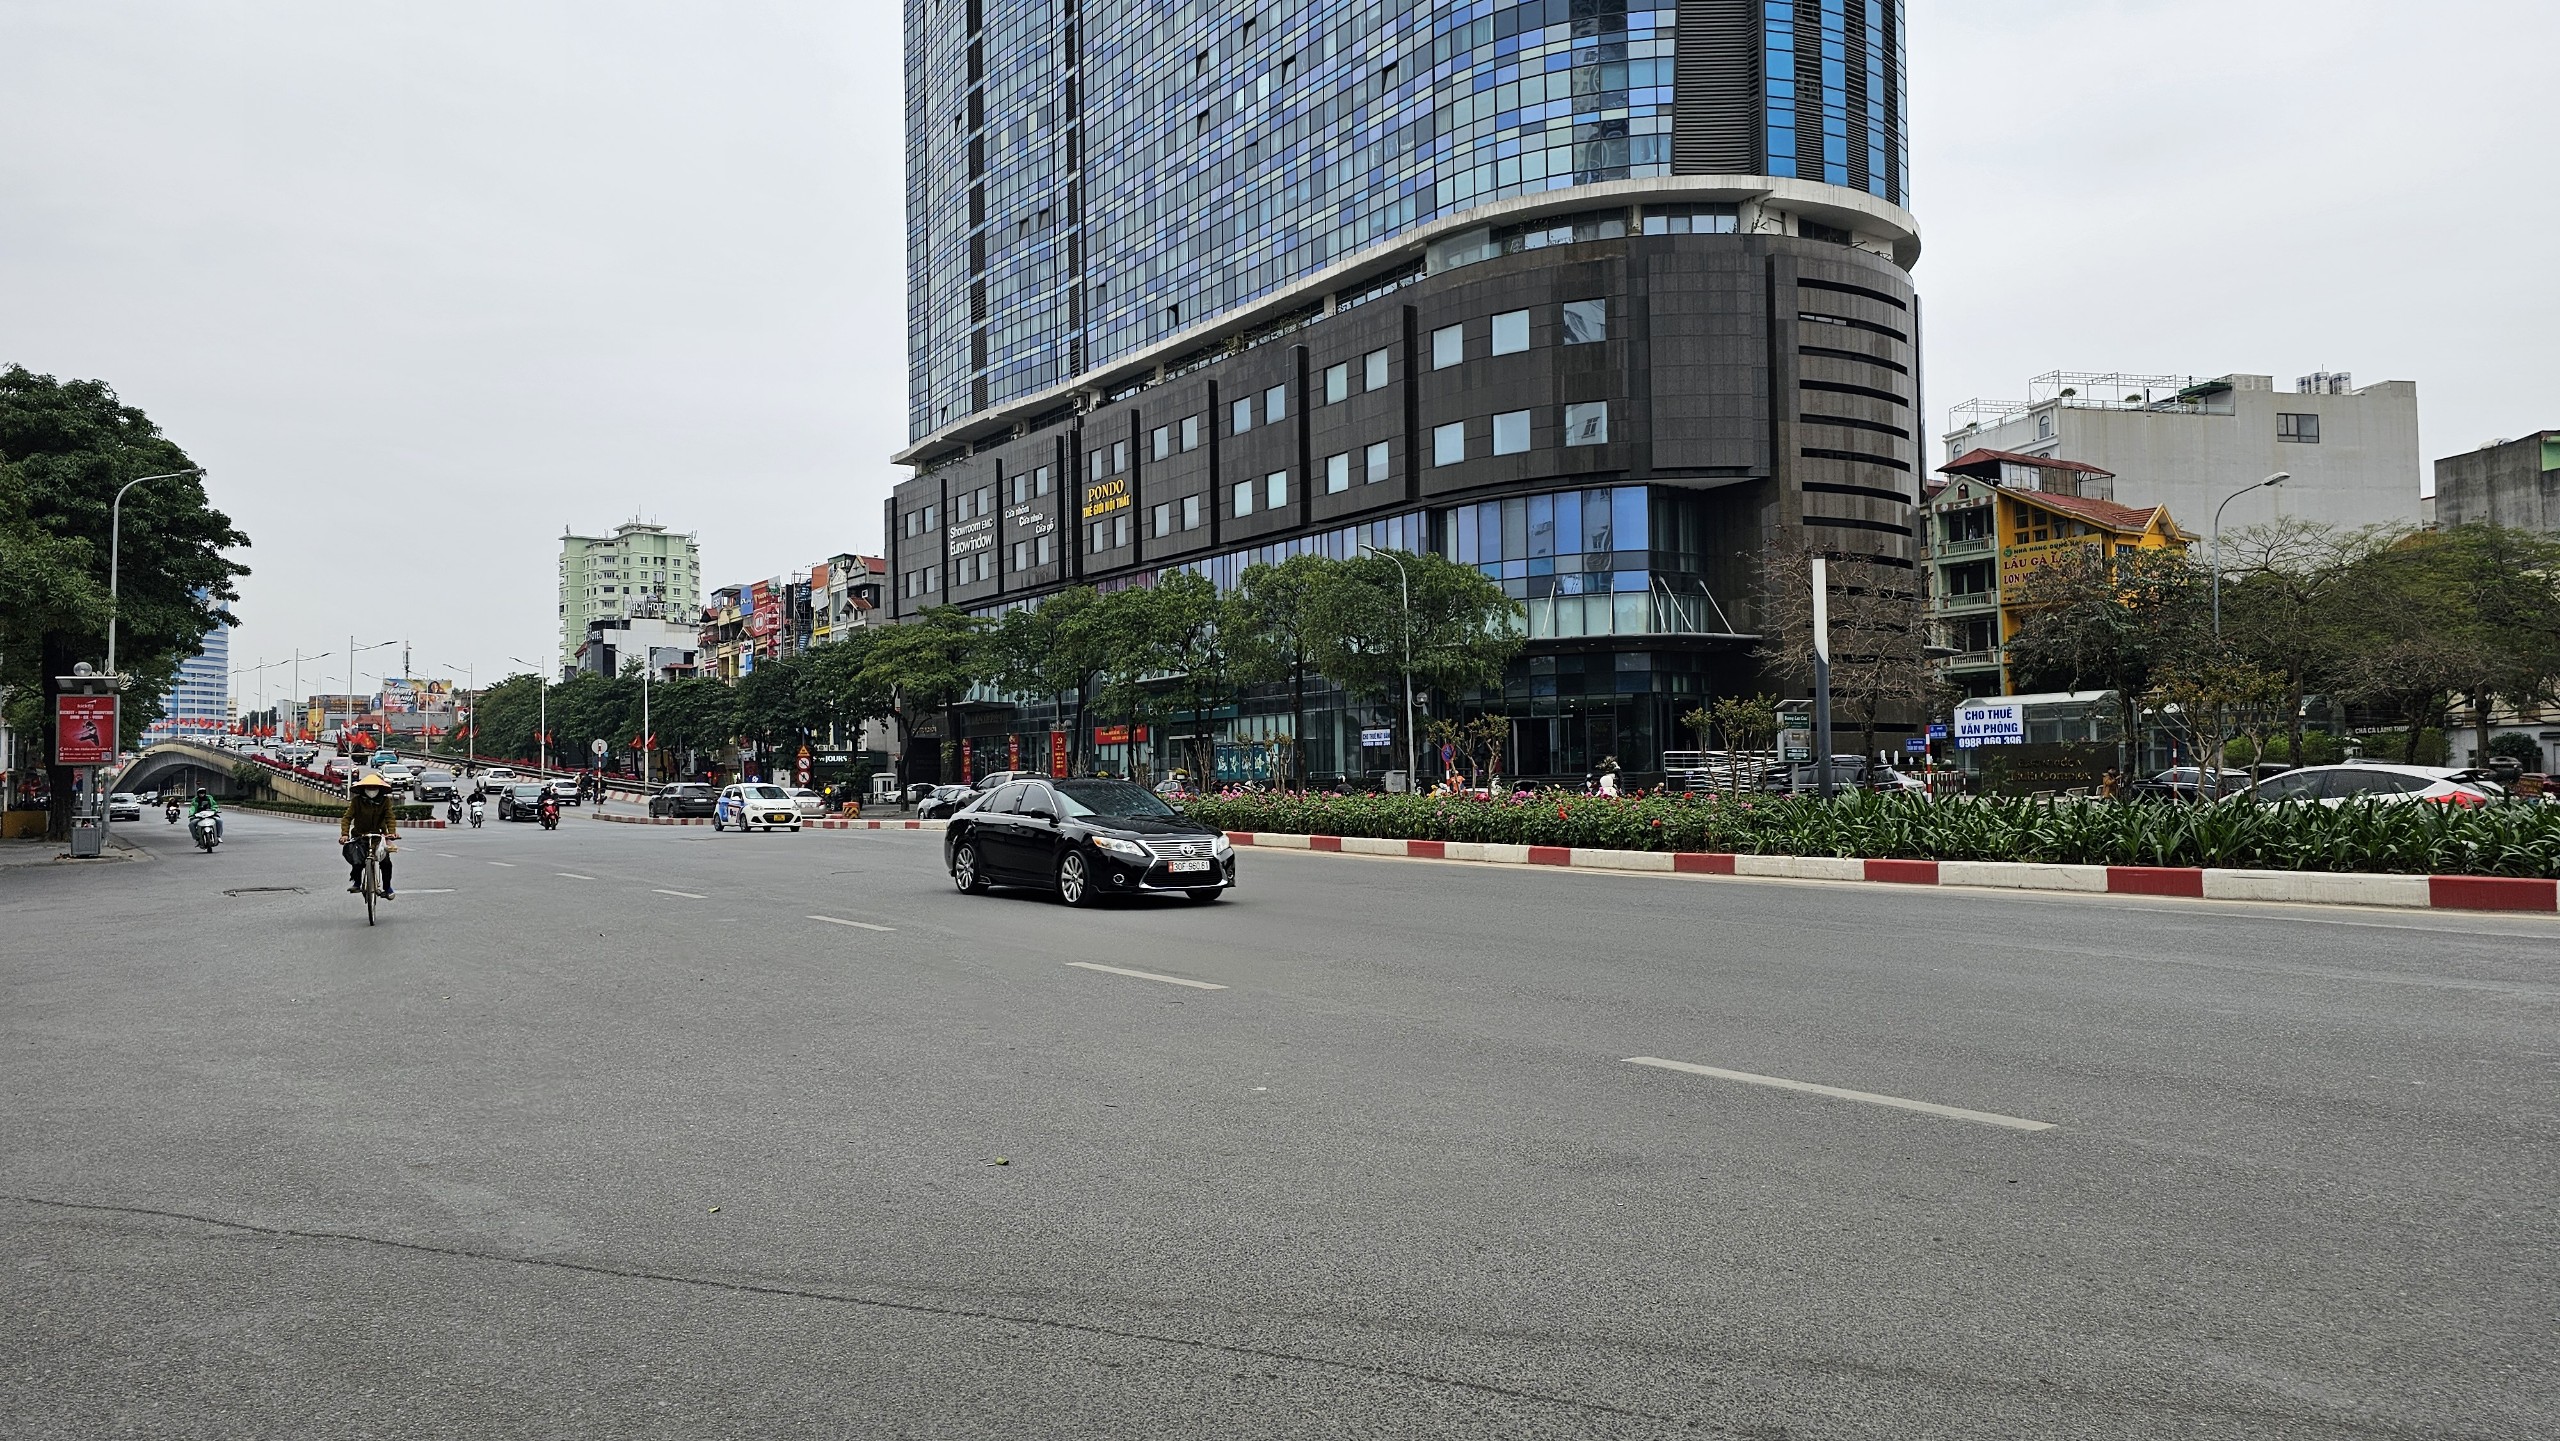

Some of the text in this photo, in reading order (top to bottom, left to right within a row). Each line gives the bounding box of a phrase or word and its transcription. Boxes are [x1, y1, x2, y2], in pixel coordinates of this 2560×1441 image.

[1088, 479, 1125, 502] PONDO
[950, 518, 994, 539] Showroom EMC
[950, 533, 993, 556] Eurowindow
[1965, 706, 2012, 720] CHO THUÊ
[1960, 721, 2018, 735] VĂN PHÒNG
[825, 755, 848, 763] JOURS
